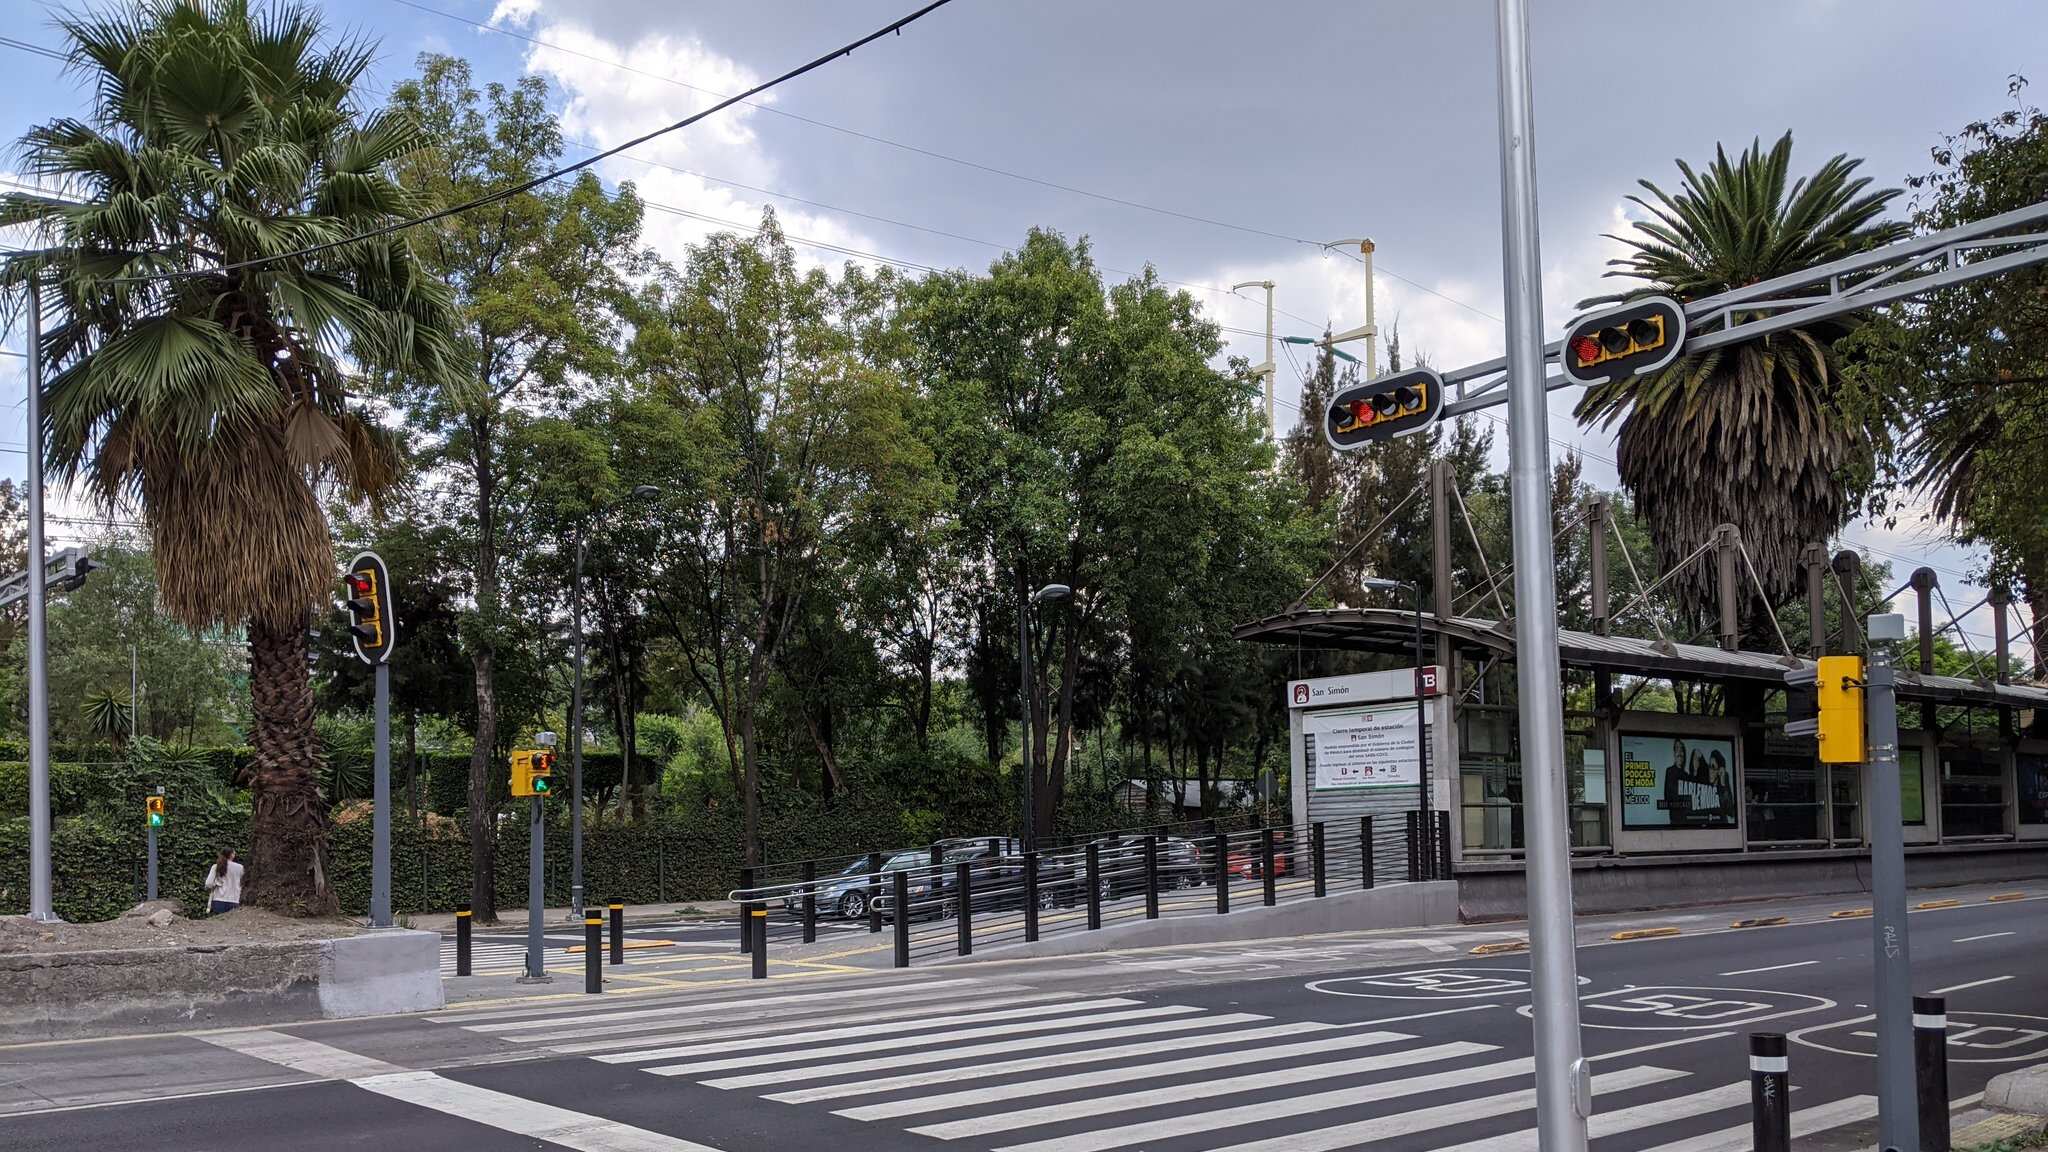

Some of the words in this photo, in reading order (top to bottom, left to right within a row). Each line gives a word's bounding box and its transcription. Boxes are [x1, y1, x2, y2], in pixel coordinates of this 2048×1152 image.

[1312, 687, 1324, 696] San
[1328, 684, 1350, 695] Simón
[1626, 762, 1649, 770] PRIMER
[1626, 770, 1655, 778] PODCAST
[1626, 778, 1634, 786] DE
[1635, 778, 1654, 786] MODA
[1361, 973, 1528, 993] 50
[1584, 994, 1774, 1019] 50
